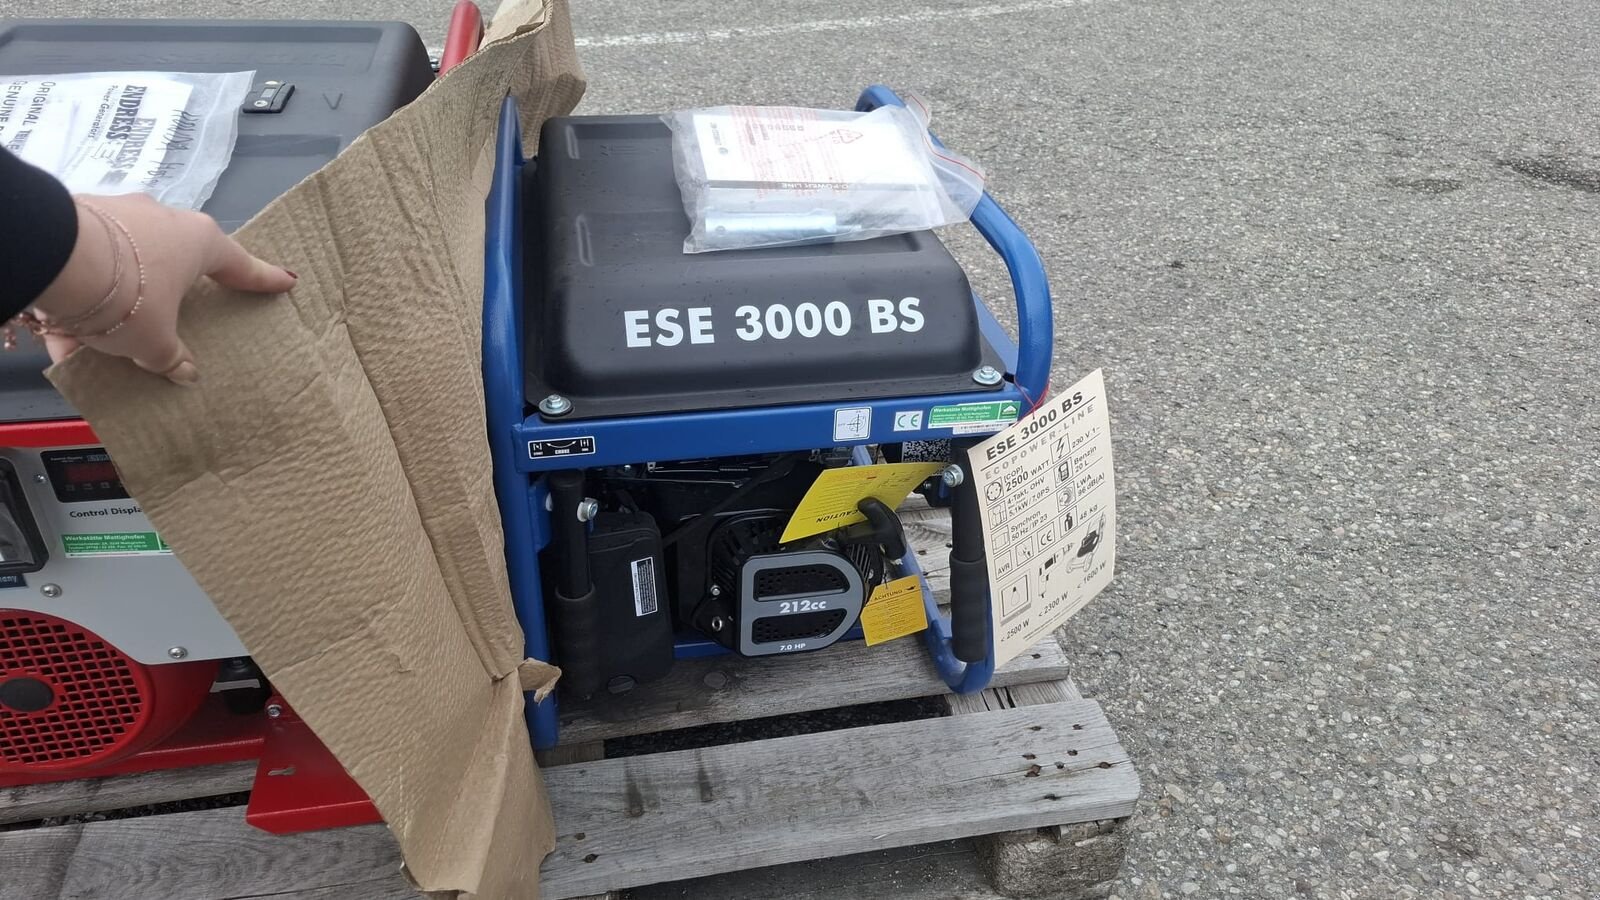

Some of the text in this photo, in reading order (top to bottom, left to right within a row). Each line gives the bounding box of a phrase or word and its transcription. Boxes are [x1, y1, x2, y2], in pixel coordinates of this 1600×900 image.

[22, 80, 56, 126] ORIGINAL
[87, 103, 110, 139] Generators
[105, 84, 148, 142] ENDRESS
[112, 117, 157, 171] ENDRESS
[624, 297, 924, 348] ESE 3000 BS
[897, 413, 920, 428] CE
[985, 434, 1018, 461] ESE
[1019, 408, 1057, 441] 3000
[1061, 391, 1083, 414] BS
[985, 404, 1095, 480] ECOPOWER-LINE
[1071, 435, 1084, 449] 230
[1085, 430, 1091, 438] V
[1073, 445, 1097, 465] Benzin
[1003, 465, 1024, 483] [COP]
[1005, 459, 1050, 492] 2500 WATT
[1029, 476, 1045, 490] OHV
[1076, 473, 1092, 489] LWA
[69, 506, 143, 519] Control Displa
[815, 508, 860, 524] CAUTION
[1010, 510, 1041, 532] Synchron
[103, 533, 146, 542] Mattighofen
[1040, 529, 1053, 546] CE
[997, 562, 1010, 576] AVR
[1099, 559, 1107, 570] W
[873, 588, 903, 601] ACHTUNG
[1043, 596, 1060, 614] 2300
[1060, 591, 1069, 601] W
[779, 599, 827, 614] 212cc
[1006, 623, 1022, 640] 2500
[1022, 618, 1030, 627] W
[780, 642, 807, 651] 7.0 HP
